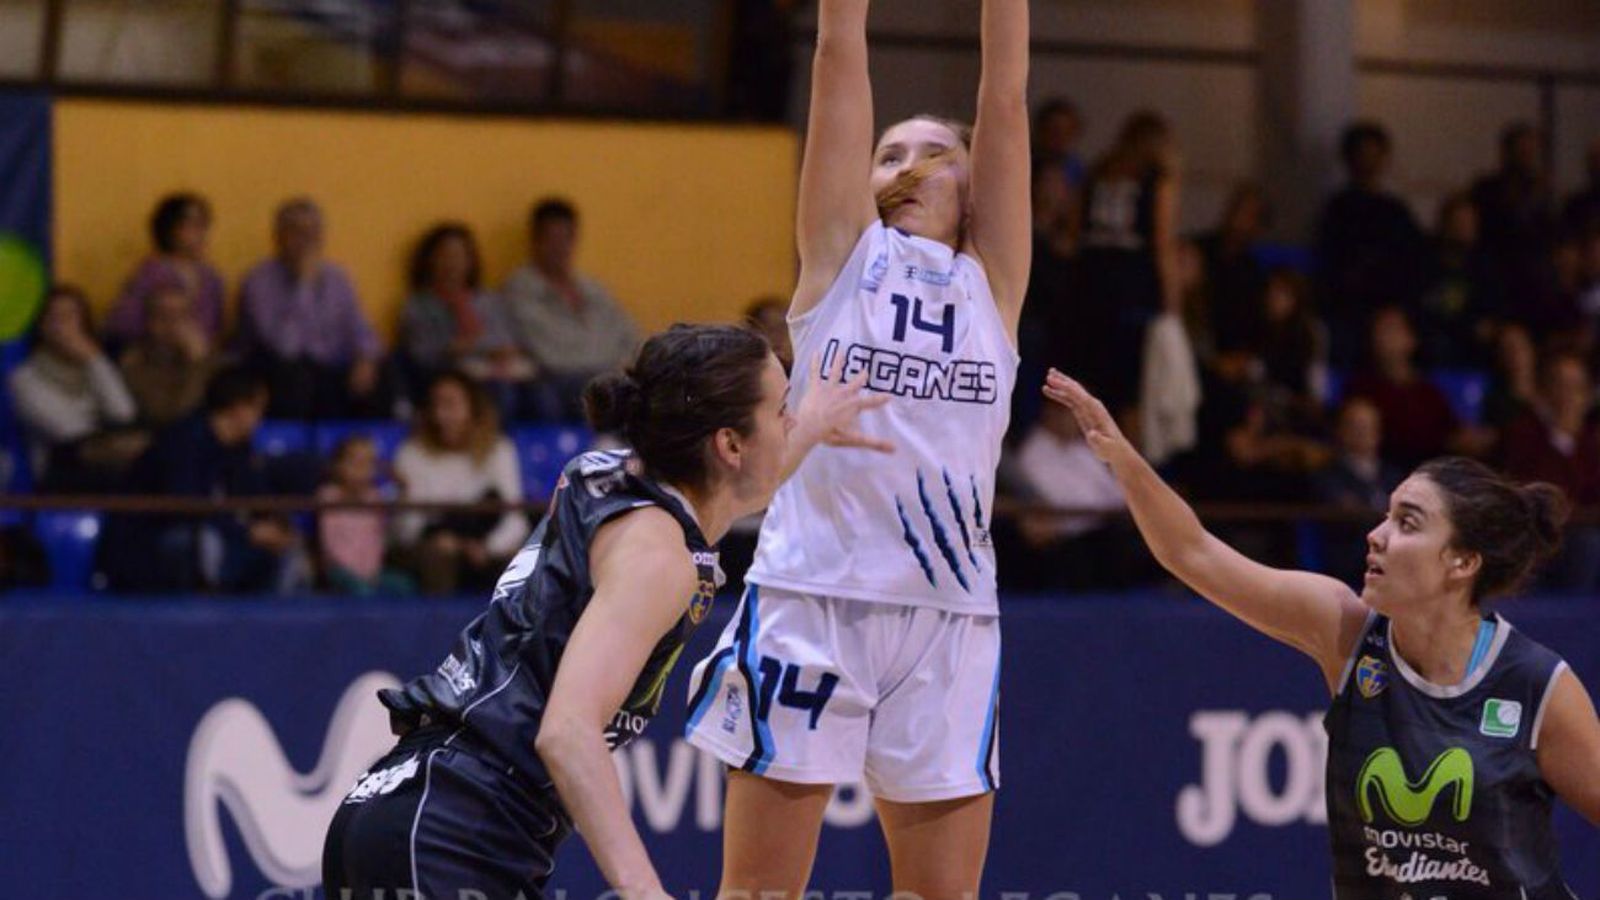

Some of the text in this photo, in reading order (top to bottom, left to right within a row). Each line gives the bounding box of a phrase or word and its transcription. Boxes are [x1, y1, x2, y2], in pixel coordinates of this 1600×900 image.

[890, 293, 955, 353] 14
[757, 656, 840, 730] 14
[1177, 711, 1328, 846] JO
[1364, 846, 1490, 886] Eudiantes
